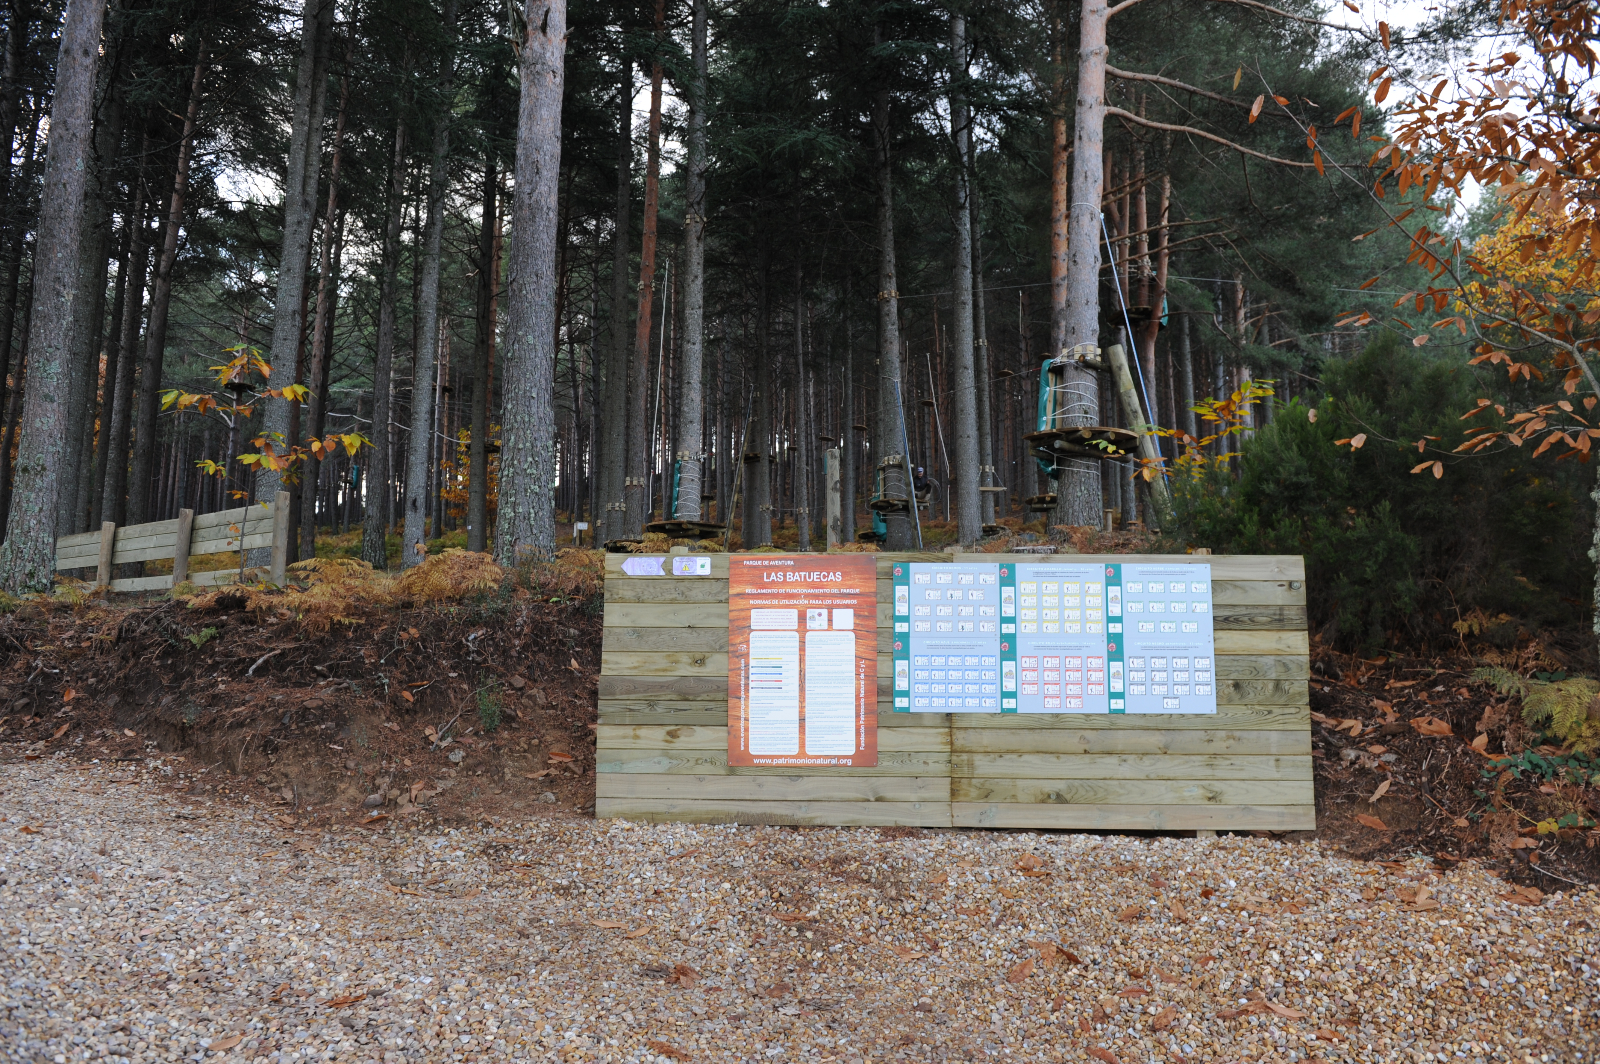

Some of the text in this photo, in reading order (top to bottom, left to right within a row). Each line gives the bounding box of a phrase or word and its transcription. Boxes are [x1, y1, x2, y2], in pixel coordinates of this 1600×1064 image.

[764, 572, 842, 582] LAS BATUECAS
[753, 757, 852, 765] www.patrimonionatural.org
